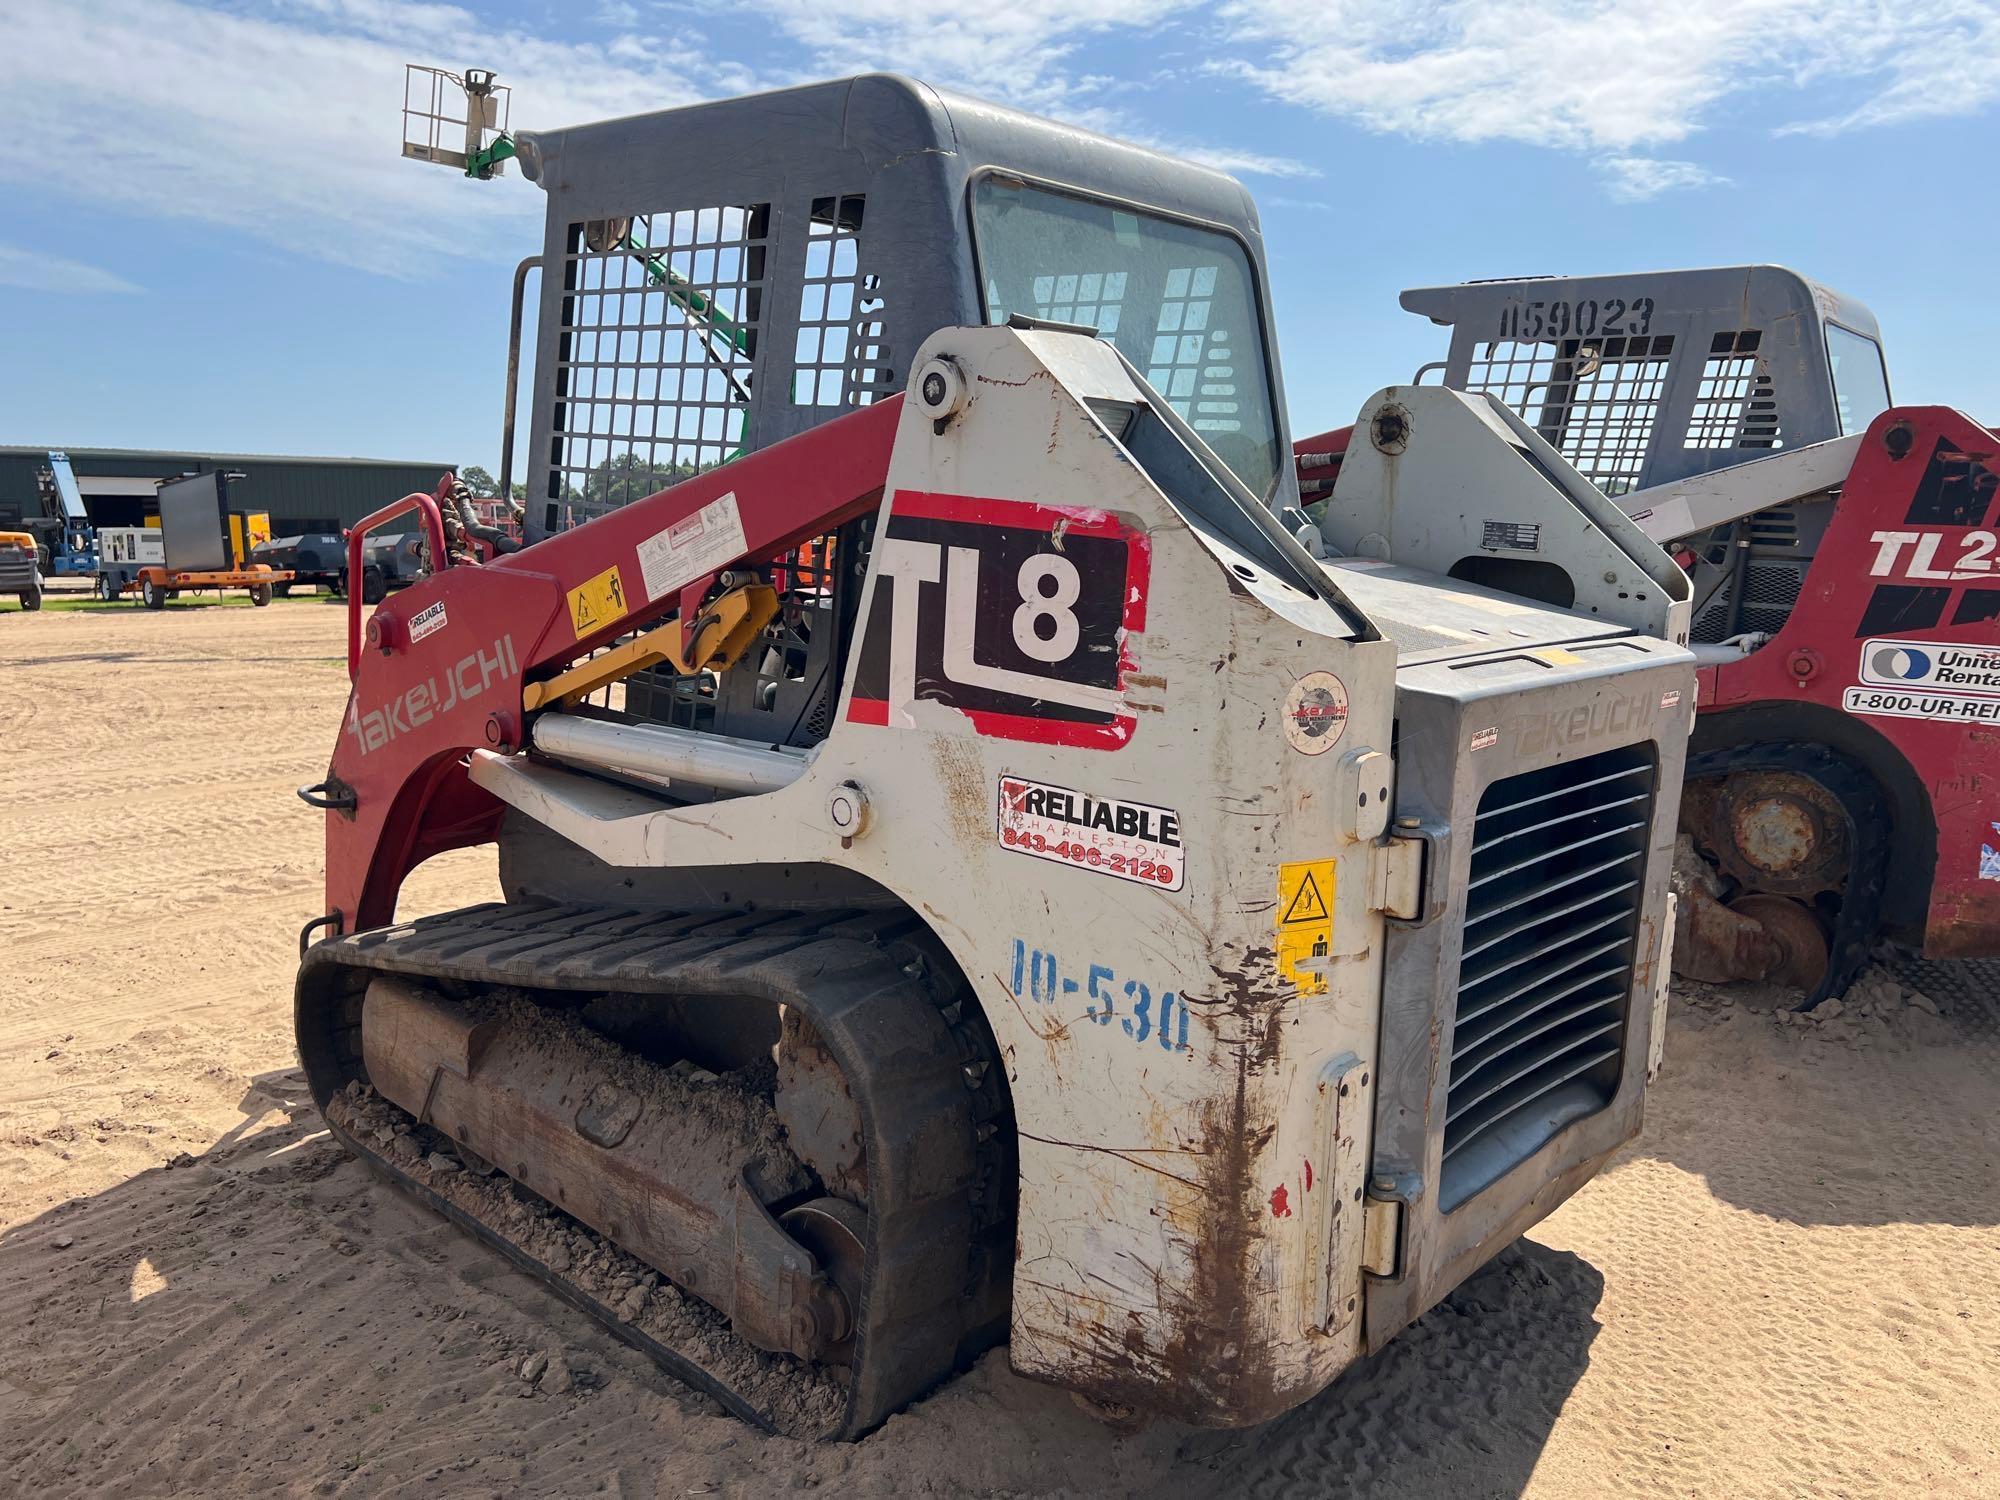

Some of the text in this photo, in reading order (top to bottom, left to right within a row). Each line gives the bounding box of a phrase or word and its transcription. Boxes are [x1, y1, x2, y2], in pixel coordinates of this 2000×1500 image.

[1869, 530, 2000, 580] TL2
[877, 537, 1136, 729] TL8
[1025, 785, 1181, 848] RELIABLE
[1003, 826, 1174, 885] 843-496-2129
[1011, 936, 1190, 1052] 10-530
